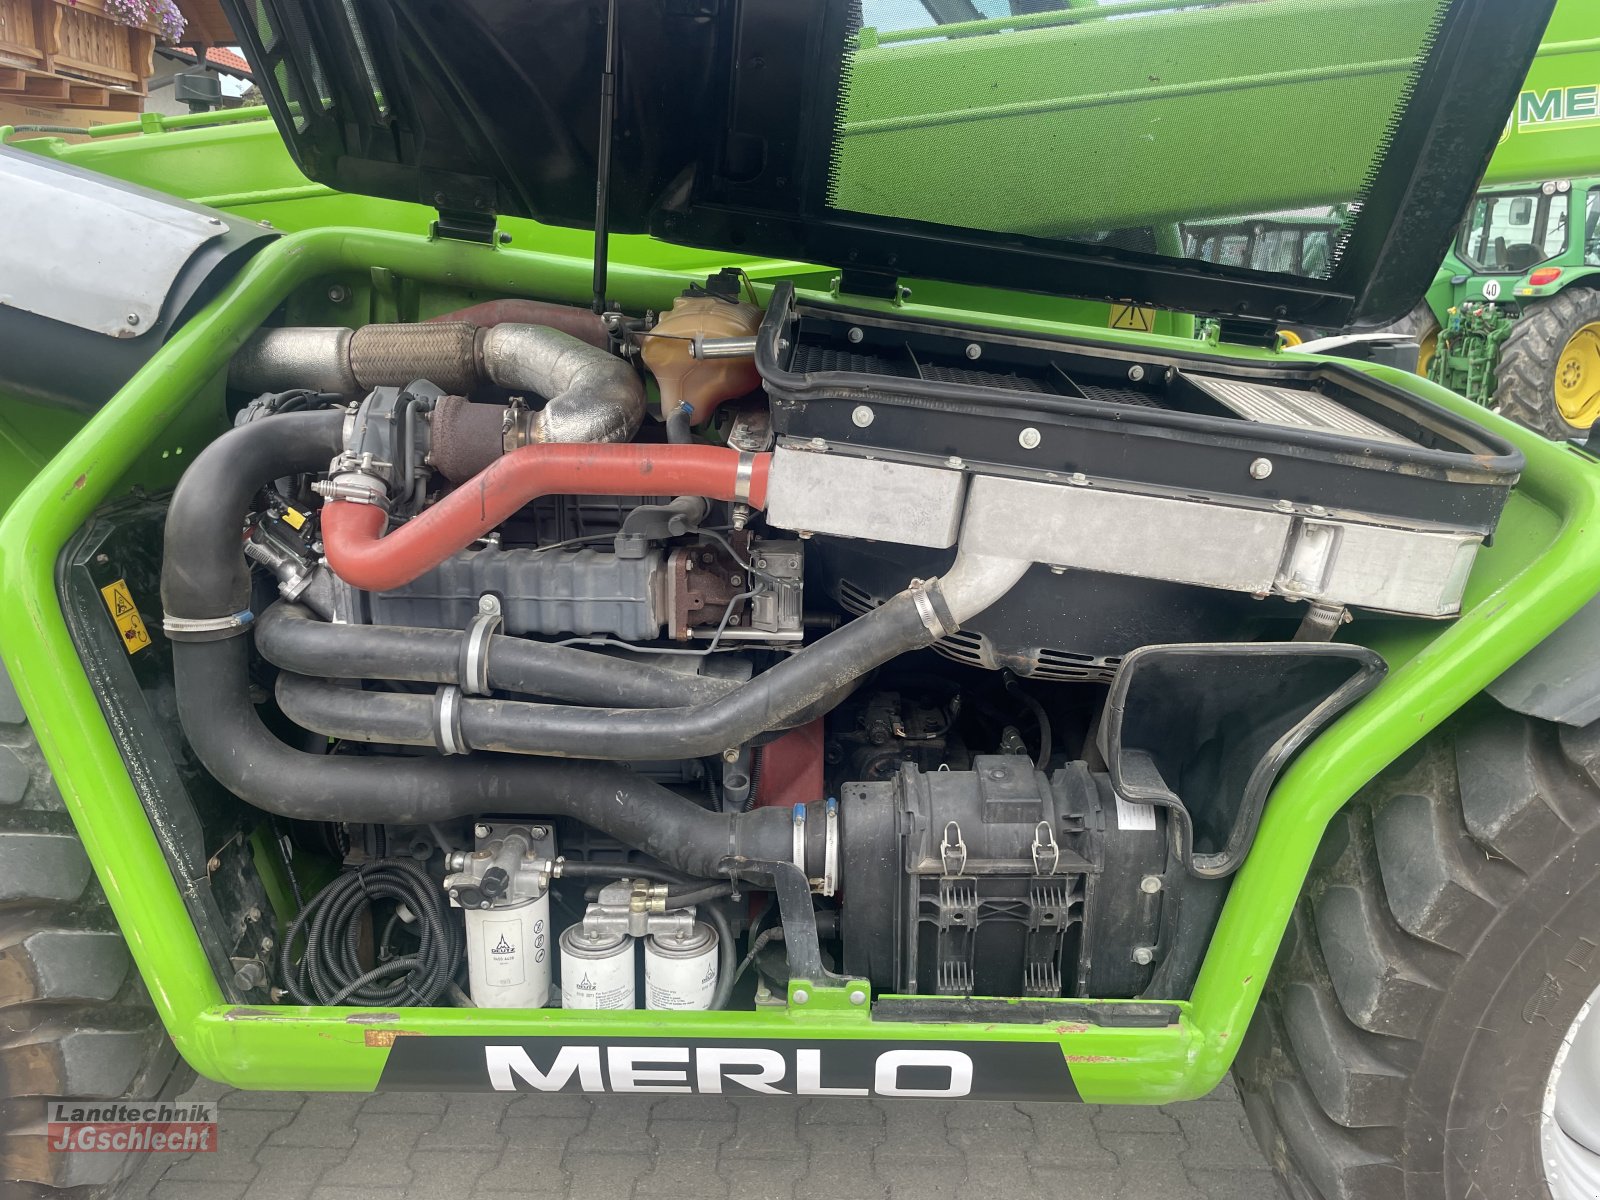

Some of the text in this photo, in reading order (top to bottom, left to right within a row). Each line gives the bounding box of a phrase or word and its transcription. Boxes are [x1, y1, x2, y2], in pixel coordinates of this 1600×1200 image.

[1518, 84, 1600, 123] ME
[1486, 283, 1497, 297] 40
[484, 1045, 974, 1097] MERLO
